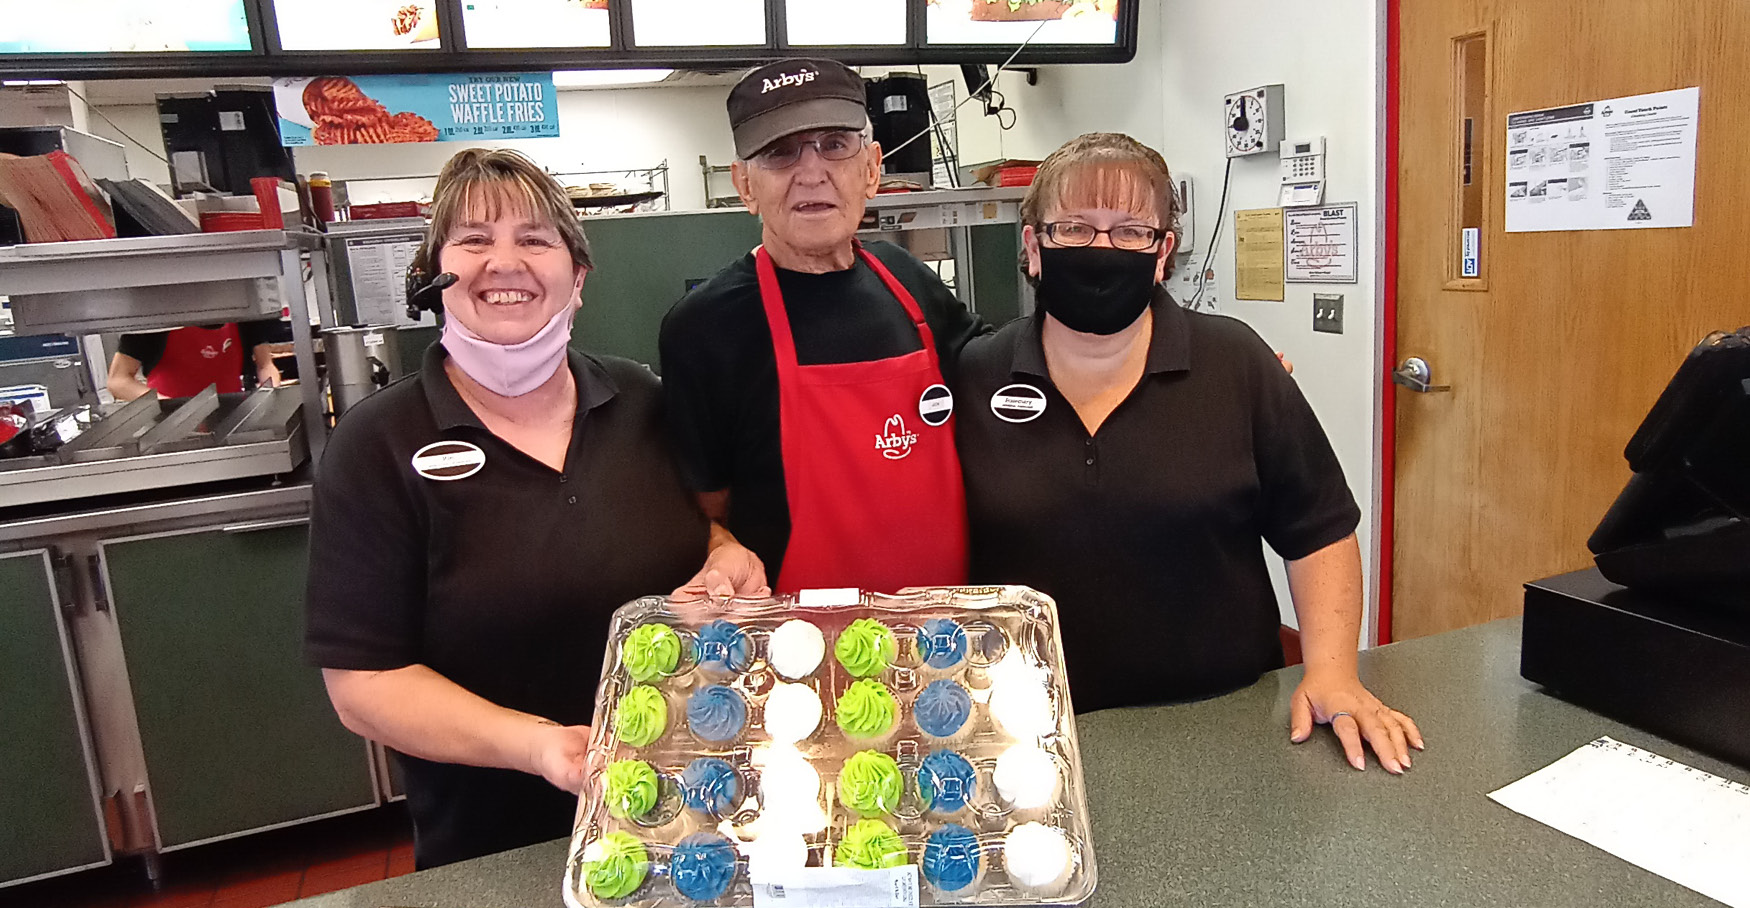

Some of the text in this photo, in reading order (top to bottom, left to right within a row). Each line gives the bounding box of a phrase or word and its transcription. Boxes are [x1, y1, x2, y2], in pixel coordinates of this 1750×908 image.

[761, 68, 816, 93] Arby's
[449, 83, 543, 103] SWEET POTATO
[450, 101, 545, 124] WAFFLE FRIES
[1323, 209, 1344, 217] BLAST
[875, 430, 918, 450] Arby's
